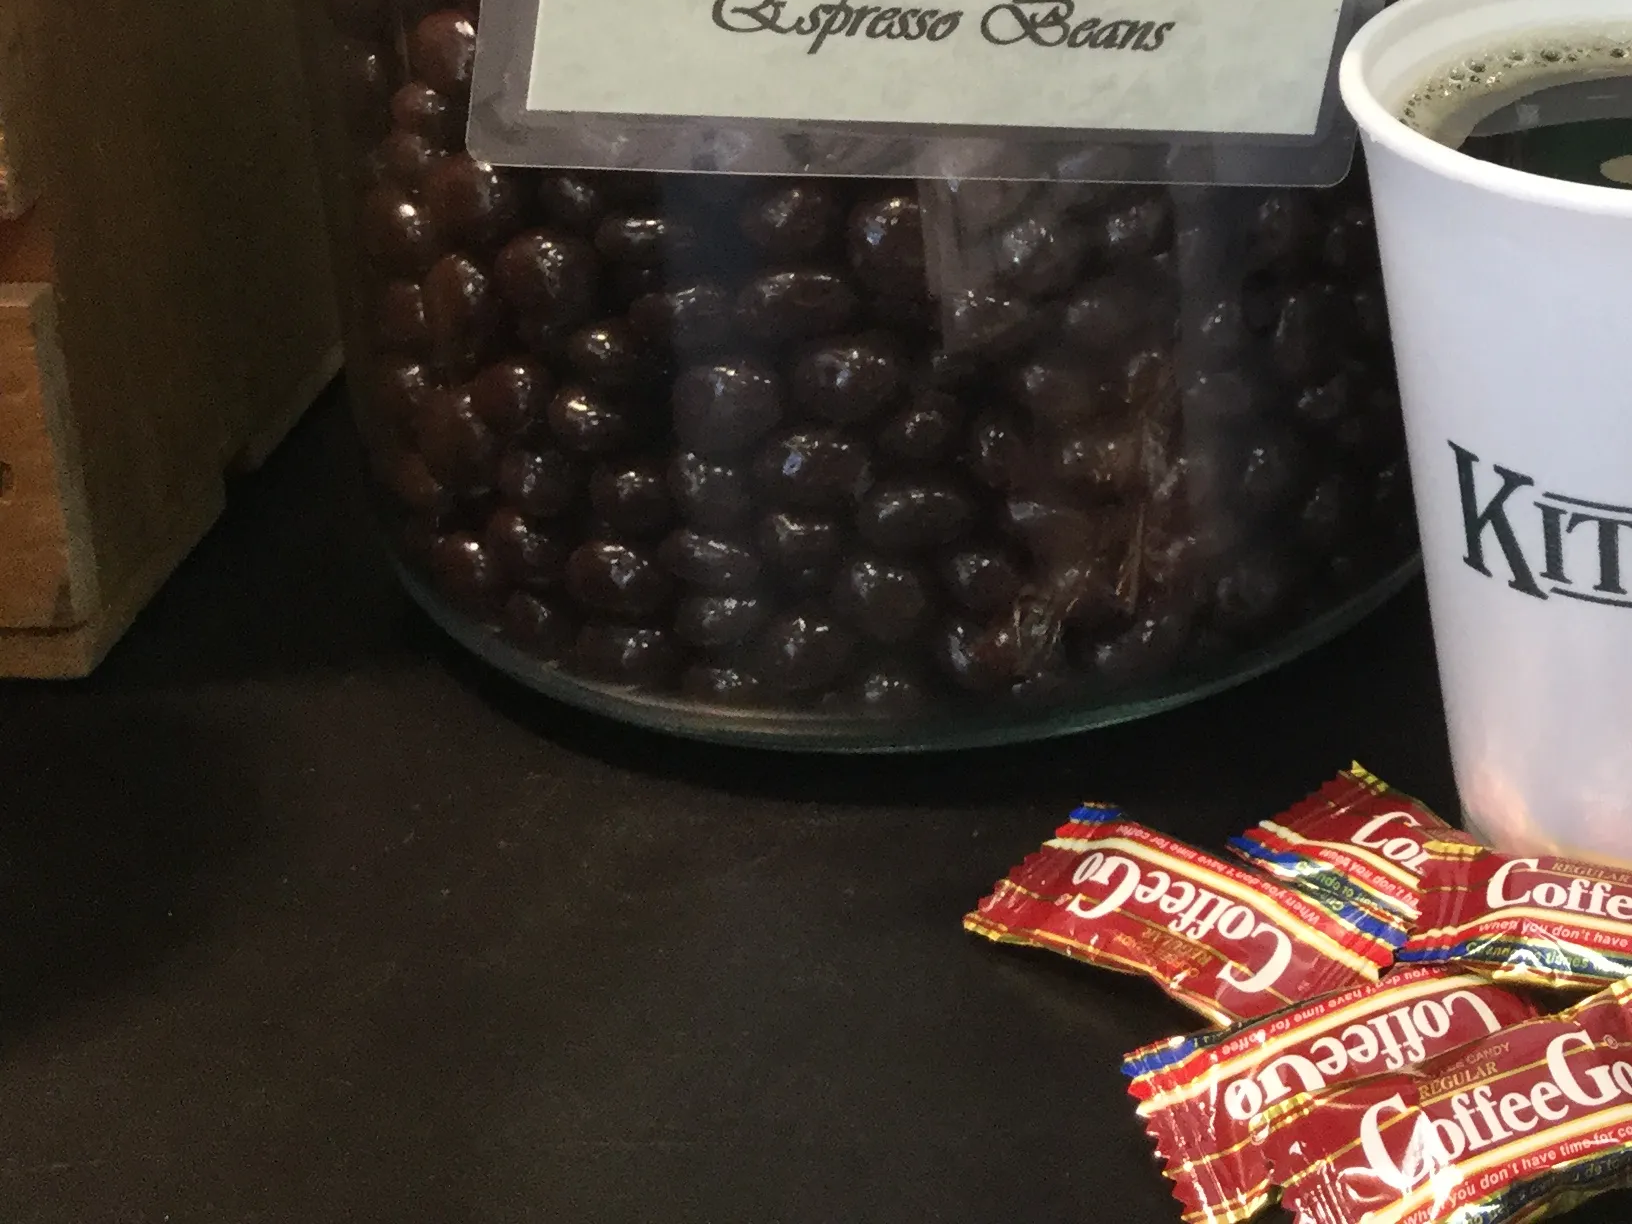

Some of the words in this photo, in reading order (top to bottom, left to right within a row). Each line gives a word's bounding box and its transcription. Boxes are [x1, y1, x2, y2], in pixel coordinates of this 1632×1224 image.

[1551, 860, 1632, 884] REGULAR
[1260, 881, 1289, 899] you
[1072, 852, 1293, 993] CoffeeGo
[1284, 895, 1321, 926] When
[1551, 924, 1591, 942] don't
[1593, 932, 1629, 949] have
[1404, 966, 1430, 980] you
[1327, 988, 1363, 1009] have
[1293, 1003, 1326, 1024] time
[1269, 1018, 1291, 1035] for
[1466, 1040, 1511, 1066] CANDY
[1417, 1060, 1499, 1101] REGULAR
[1448, 1180, 1477, 1209] you
[1479, 1161, 1520, 1191] don't
[1521, 1149, 1557, 1172] have
[1559, 1137, 1592, 1157] time
[1592, 1128, 1617, 1146] for
